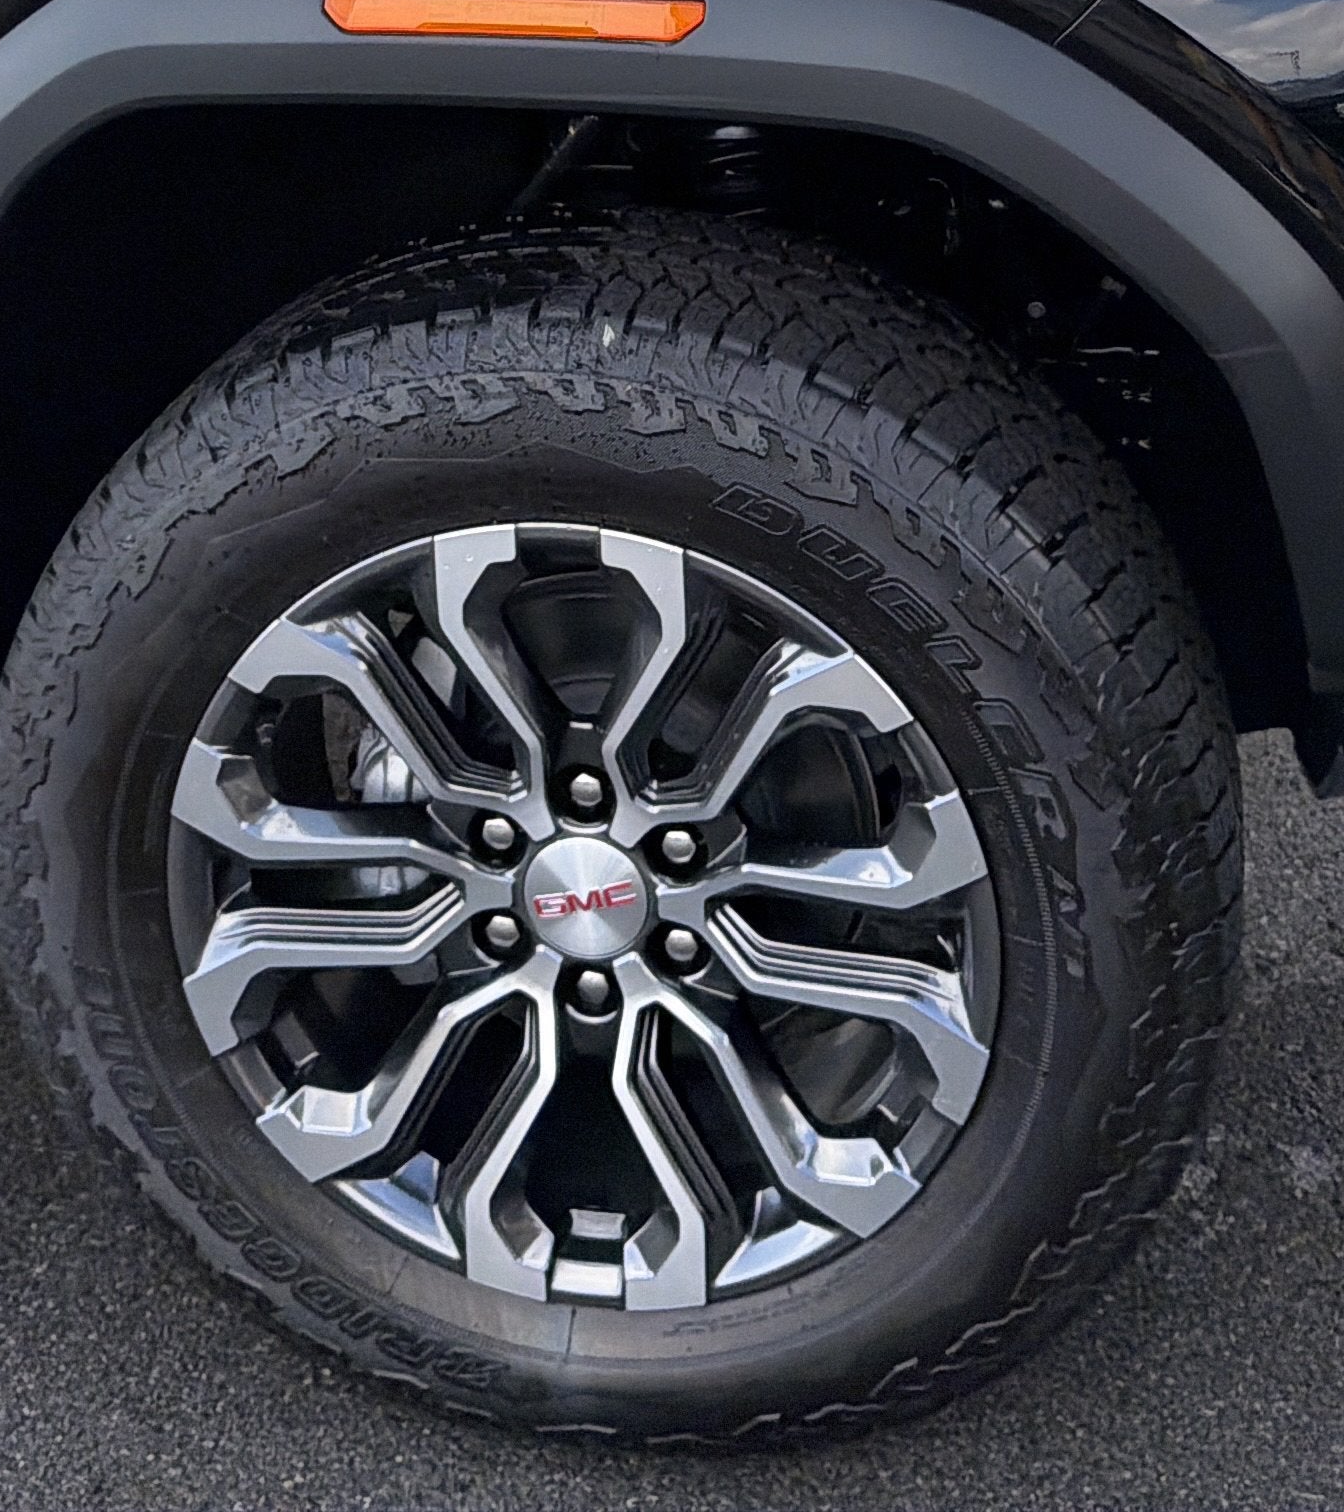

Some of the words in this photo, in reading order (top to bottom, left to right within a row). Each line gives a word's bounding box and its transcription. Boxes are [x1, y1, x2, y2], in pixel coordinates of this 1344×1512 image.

[709, 482, 1068, 841] DUELER
[532, 878, 638, 920] GMC
[69, 962, 513, 1388] BRIDGESTONE
